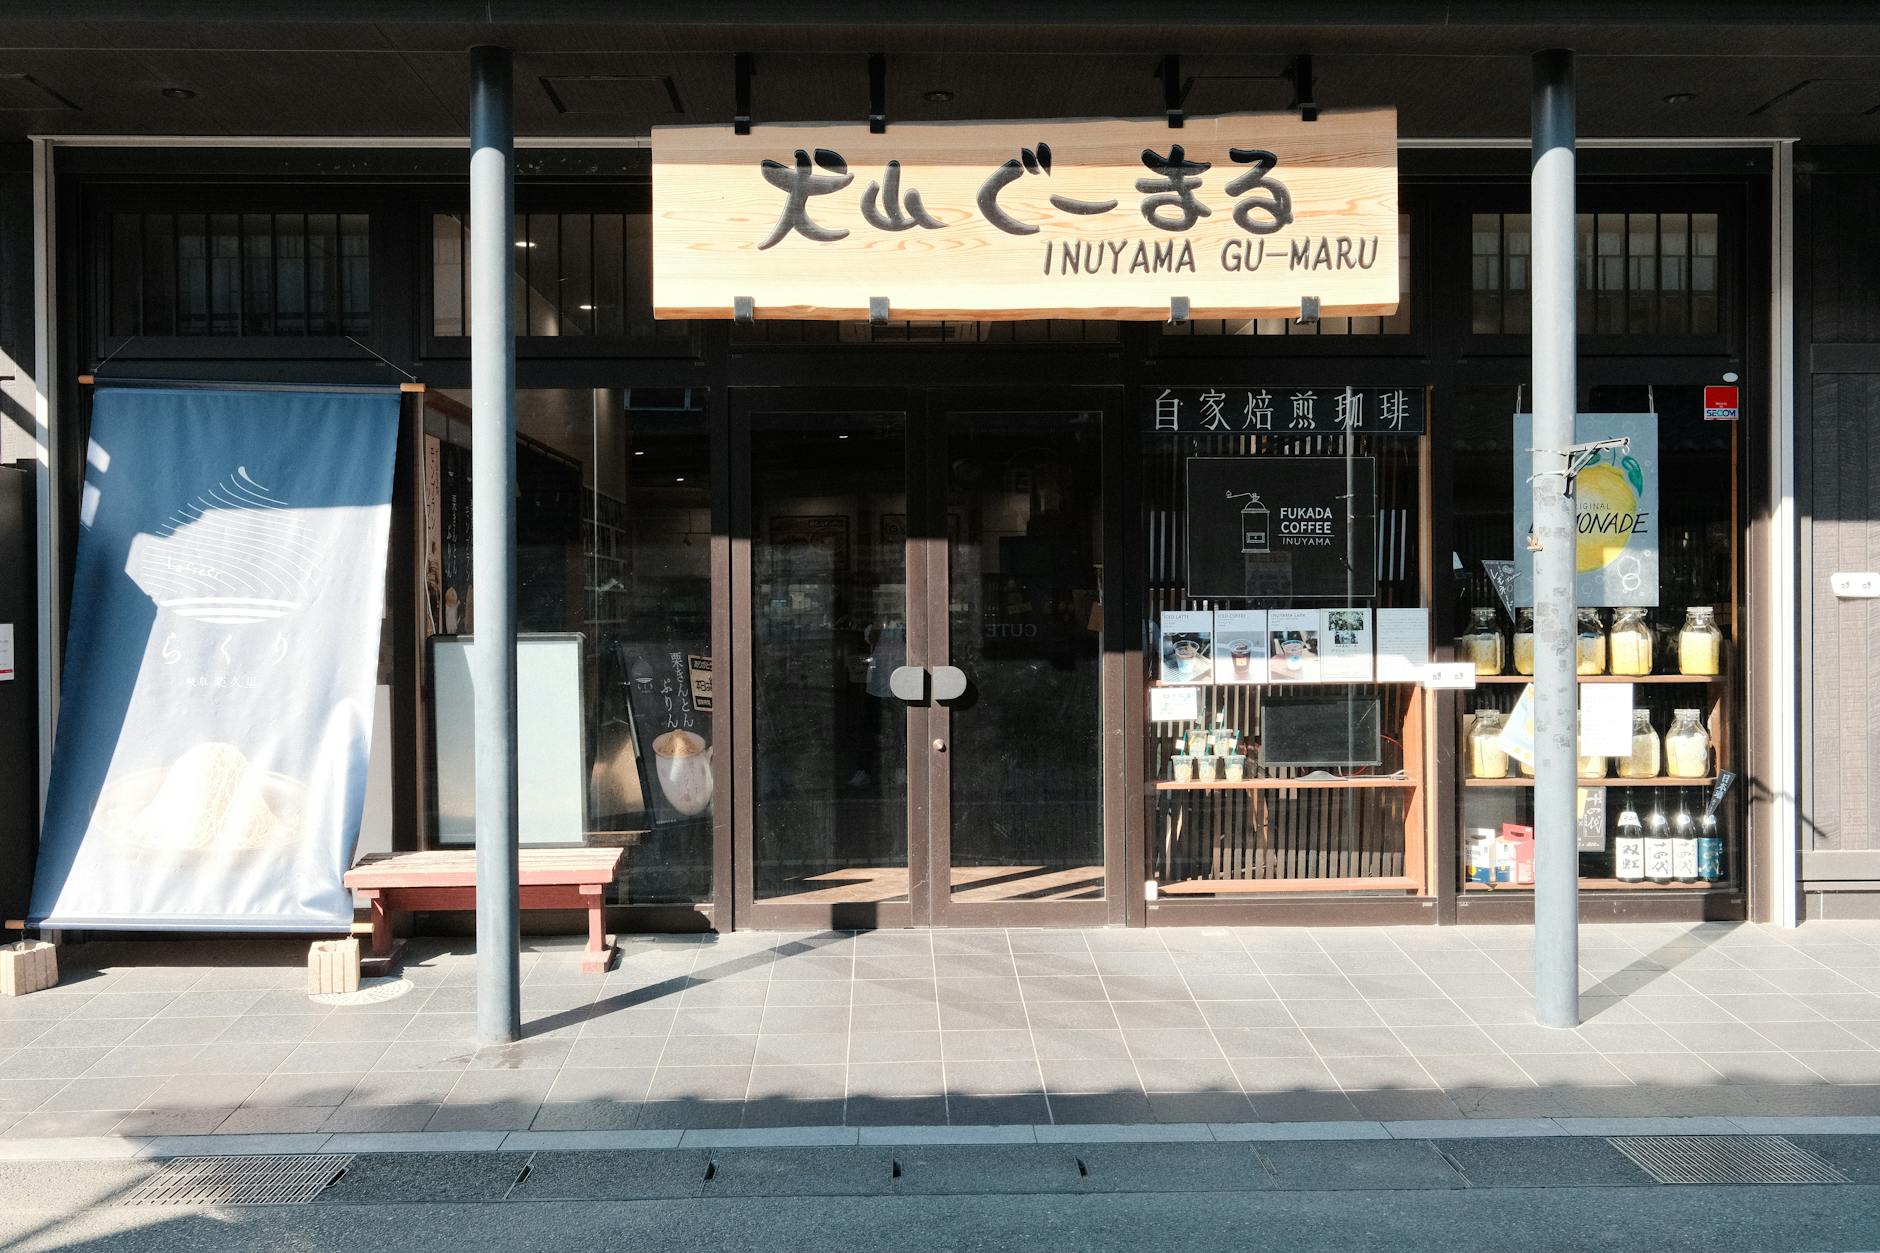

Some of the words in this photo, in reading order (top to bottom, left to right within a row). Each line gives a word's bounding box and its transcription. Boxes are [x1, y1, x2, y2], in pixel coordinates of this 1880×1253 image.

[757, 141, 1294, 250] 犬山ぐーまる
[1043, 238, 1197, 276] INUYAMA
[1155, 388, 1410, 431] 自家焙煎珈琲
[1706, 409, 1736, 417] SECOM
[1280, 507, 1333, 519] FUKADA
[1281, 521, 1332, 533] COFFEE
[1282, 537, 1331, 546] INUYAMA
[162, 631, 288, 666] らくり
[661, 678, 679, 728] ぷりん
[668, 652, 694, 727] 栗きんとん
